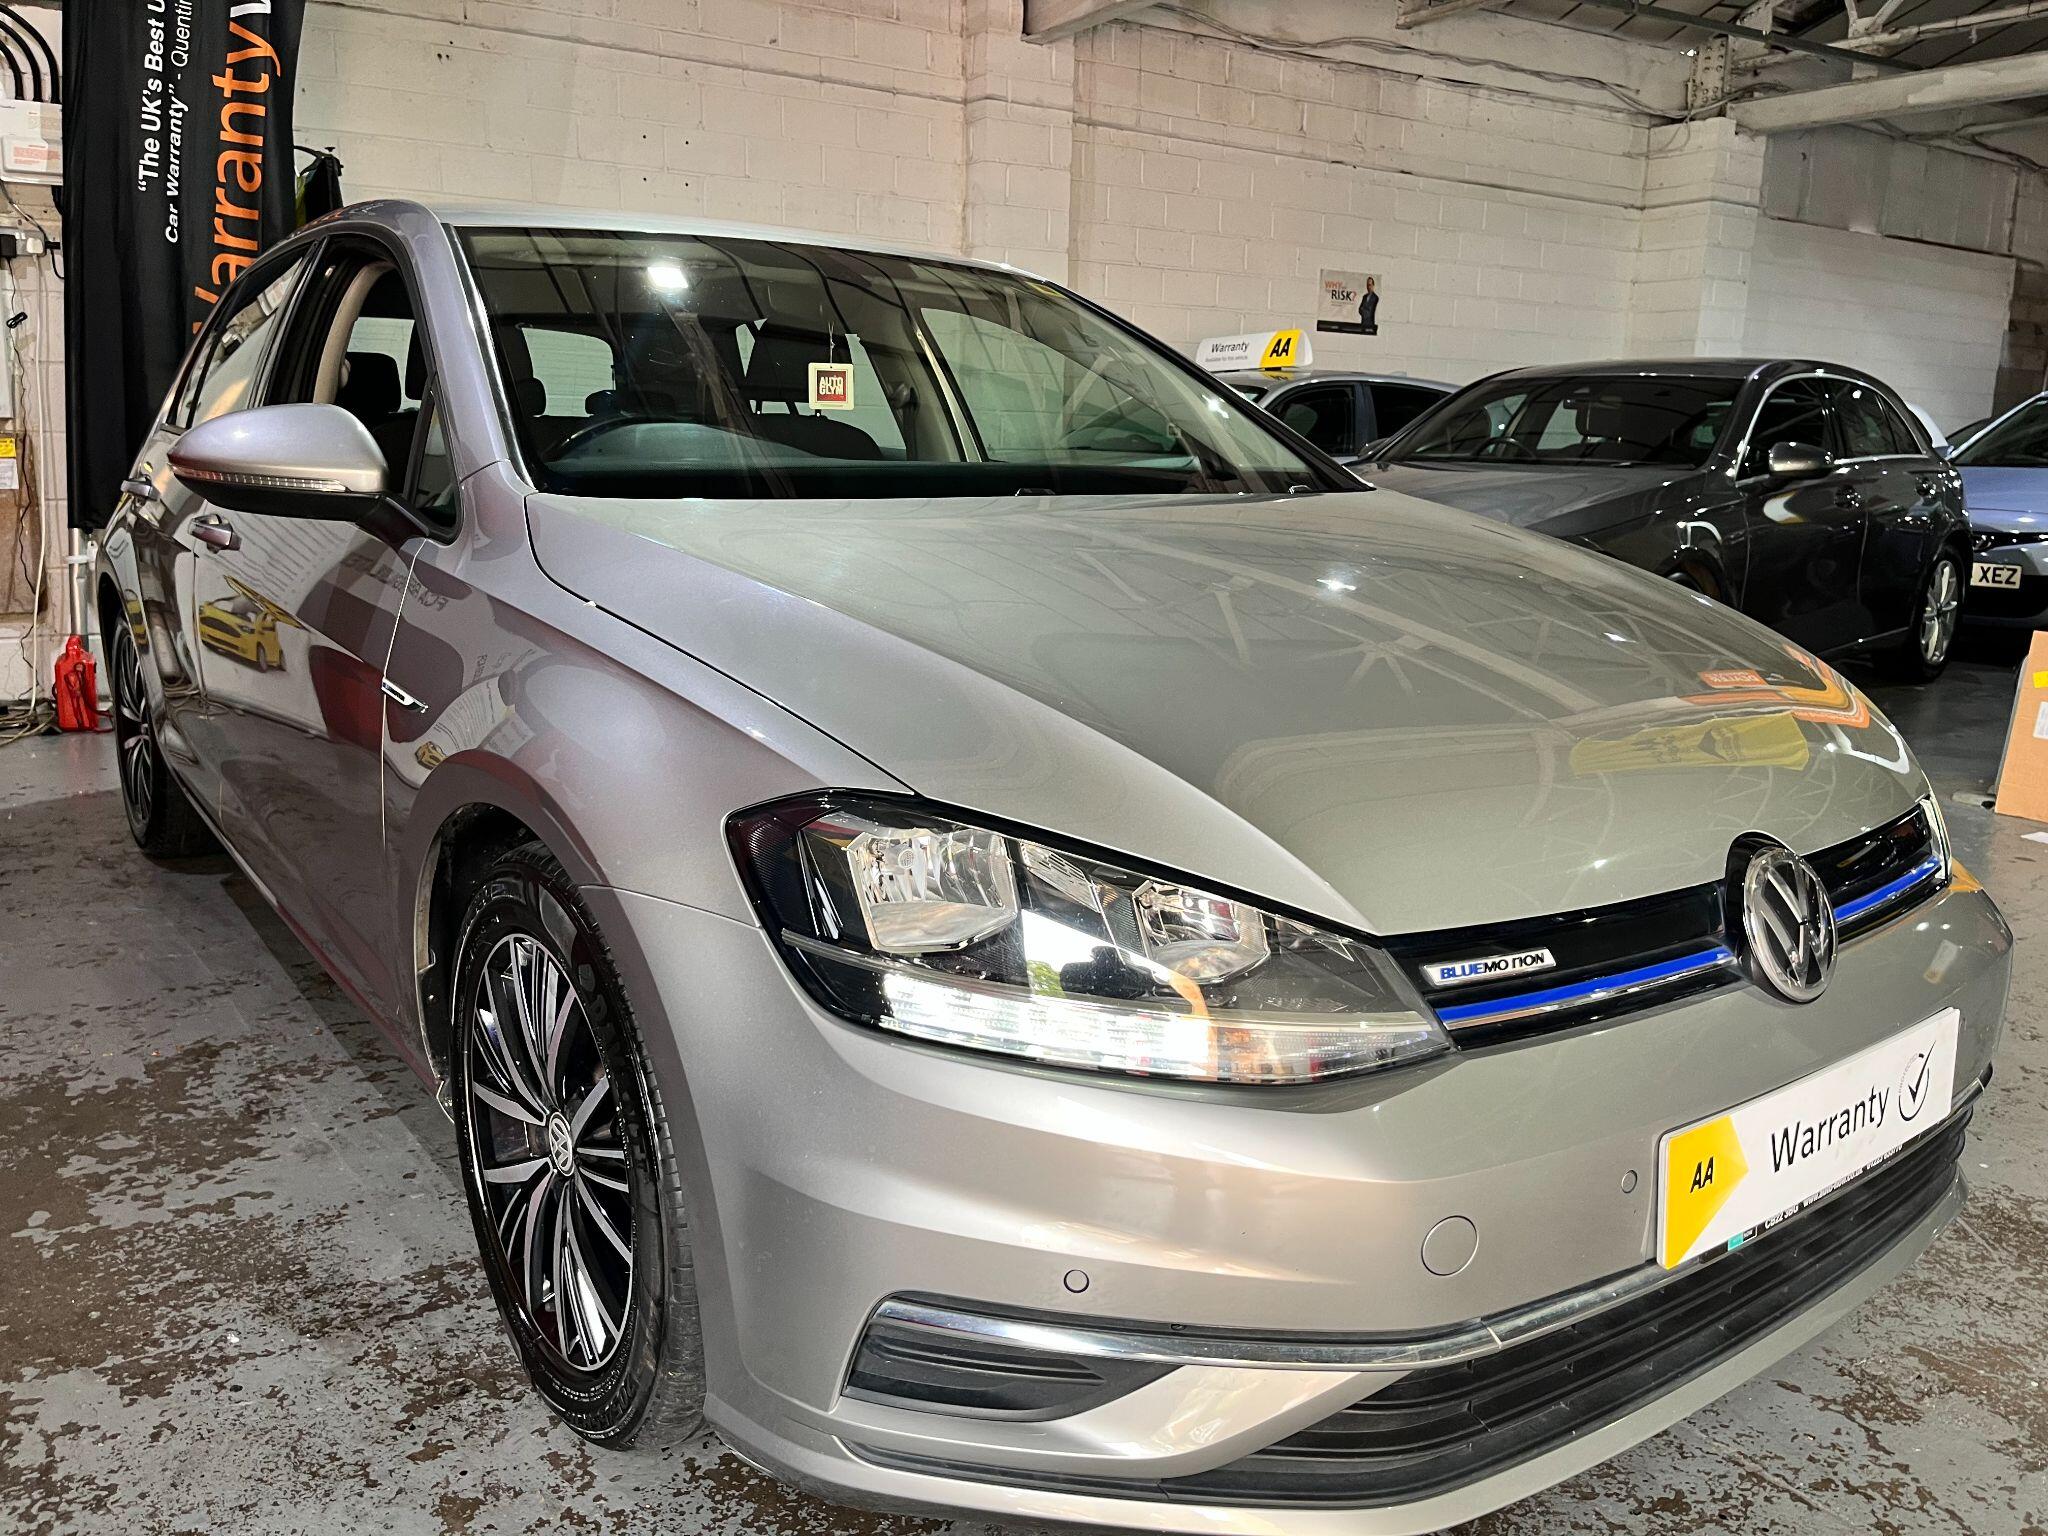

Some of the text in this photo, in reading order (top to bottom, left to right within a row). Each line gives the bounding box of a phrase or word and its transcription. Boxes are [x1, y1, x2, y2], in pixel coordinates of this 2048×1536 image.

[144, 18, 165, 73] Best
[165, 203, 179, 243] Car
[1331, 289, 1358, 302] RISK?
[1211, 340, 1250, 354] Warranty
[1269, 337, 1293, 358] AA
[819, 376, 844, 387] AUTO
[1979, 566, 2018, 585] XEZ
[1440, 952, 1545, 980] BLUEMOTION
[1771, 1085, 1890, 1174] Warranty
[1690, 1156, 1714, 1193] AA
